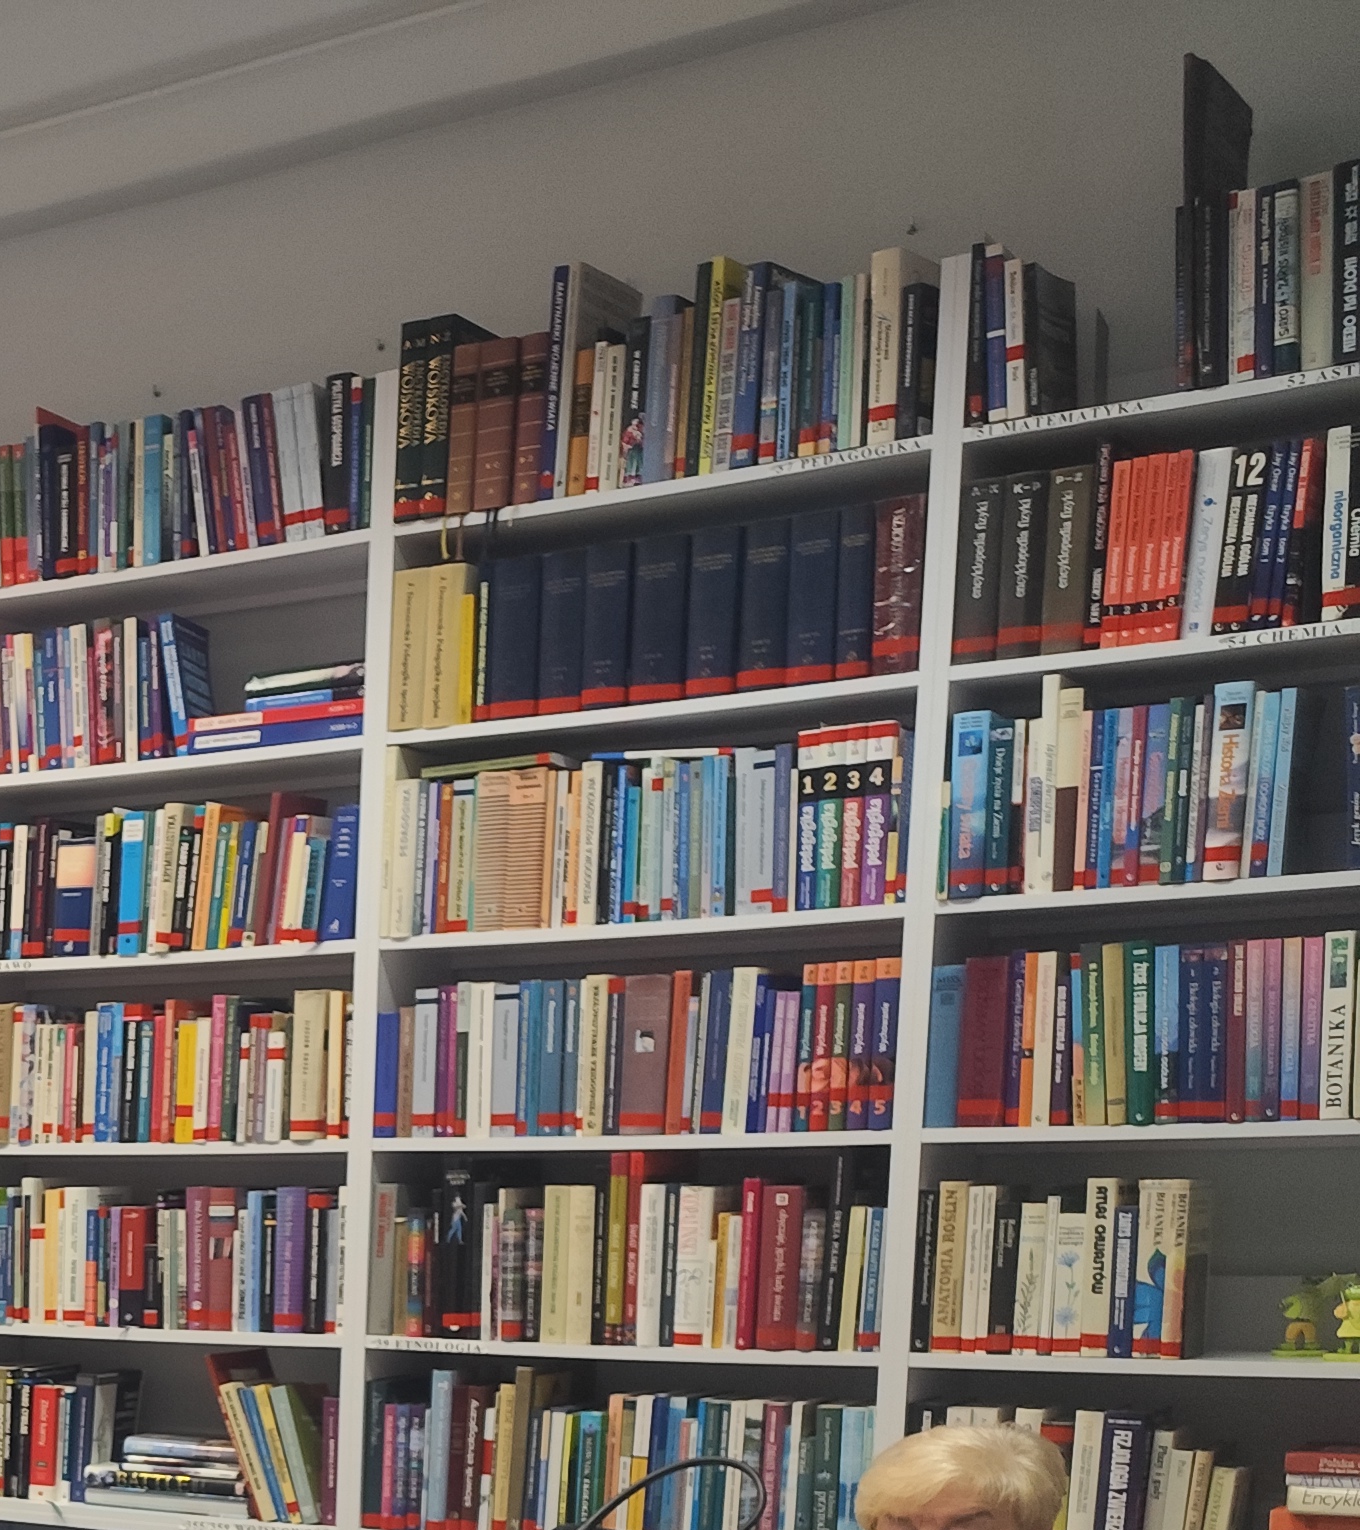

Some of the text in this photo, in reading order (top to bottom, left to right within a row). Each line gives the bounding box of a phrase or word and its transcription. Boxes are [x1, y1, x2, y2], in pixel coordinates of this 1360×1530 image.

[552, 281, 565, 346] MARYNARKI
[397, 362, 416, 450] WOJSKOWA
[422, 356, 442, 445] WOJSKOWA
[1002, 401, 1144, 431] MATEMATYKA
[1286, 373, 1307, 388] 52
[800, 440, 921, 469] PEDAGOGIKA
[1234, 455, 1248, 488] 1
[1246, 452, 1267, 486] 2
[971, 499, 989, 599] encyklopedia fizyki
[1013, 497, 1034, 598] encyklopedia fizyki
[1058, 489, 1076, 589] encyklopedia fizyki
[1262, 504, 1277, 558] fizyka tom
[1277, 504, 1292, 557] fizyka tom
[1330, 490, 1344, 580] nieorganiczna
[1349, 508, 1360, 557] Chemia
[1228, 624, 1342, 648] 54 CHEMIA
[821, 772, 838, 870] pedagogika 2
[842, 770, 861, 869] pedagogika 3
[865, 766, 885, 866] pedagogika 4
[1216, 733, 1241, 829] Historia Ziemi
[801, 775, 817, 872] pedagogika 1
[1326, 1004, 1346, 1109] BOTANIKA
[1091, 1185, 1109, 1296] ATLAS CHWASTÓW
[1152, 1191, 1167, 1248] BOTANIKA
[1174, 1192, 1189, 1249] BOTANIKA
[935, 1246, 954, 1326] ANATOMIA
[395, 1340, 482, 1353] ETNOLOGIA
